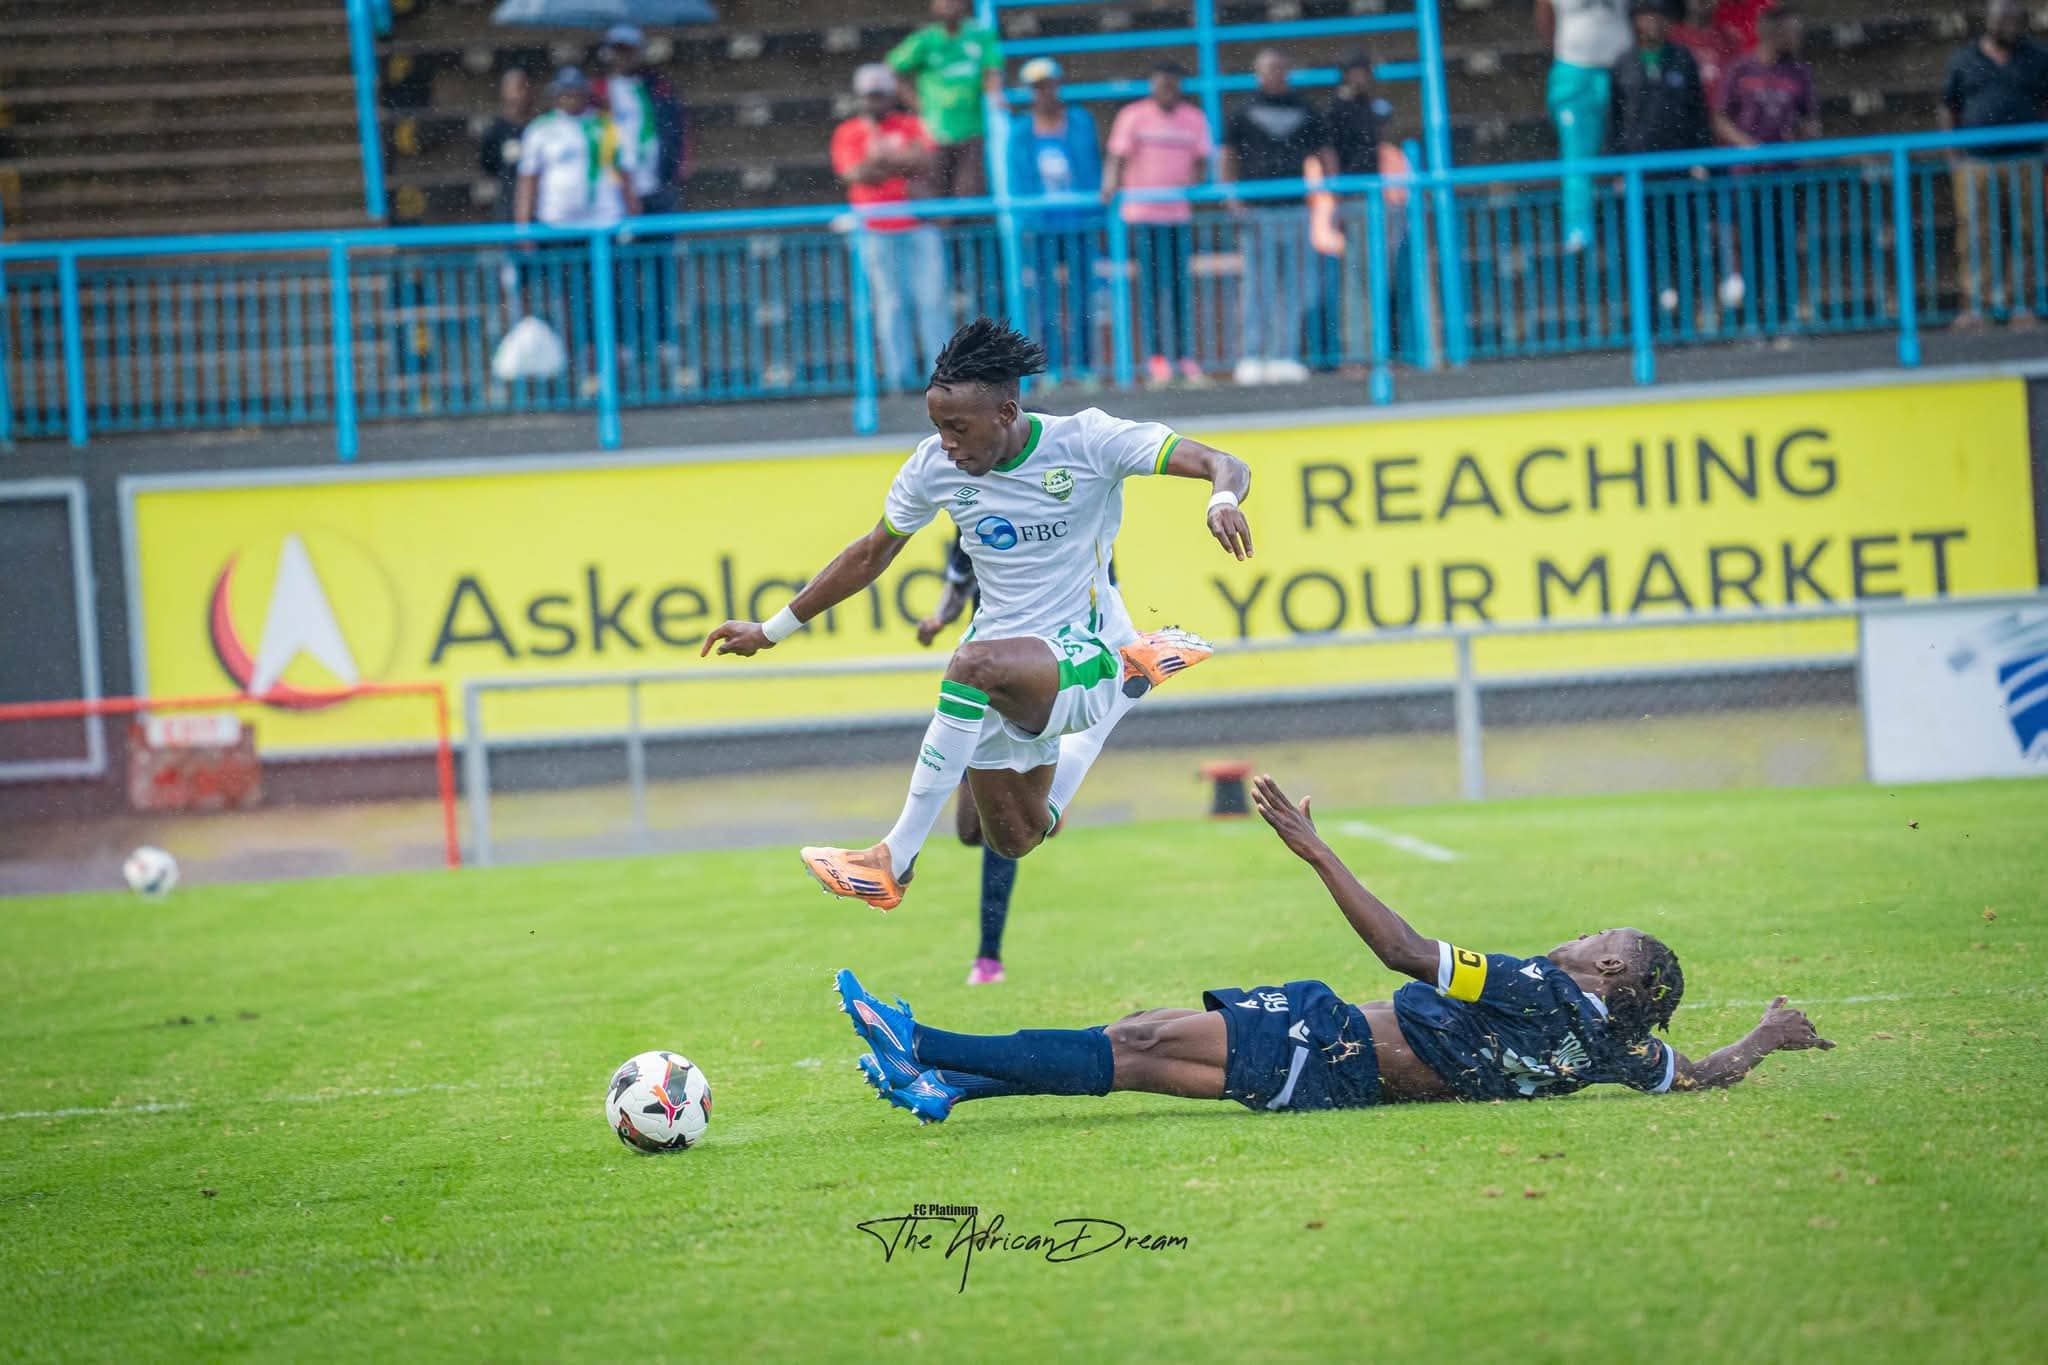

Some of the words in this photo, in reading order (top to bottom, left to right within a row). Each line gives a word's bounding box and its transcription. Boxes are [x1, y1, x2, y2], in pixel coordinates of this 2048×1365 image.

[1301, 426, 1840, 530] REACHING
[1018, 520, 1069, 542] FBC
[1212, 560, 1497, 644] YOUR
[1534, 528, 1968, 622] MARKET
